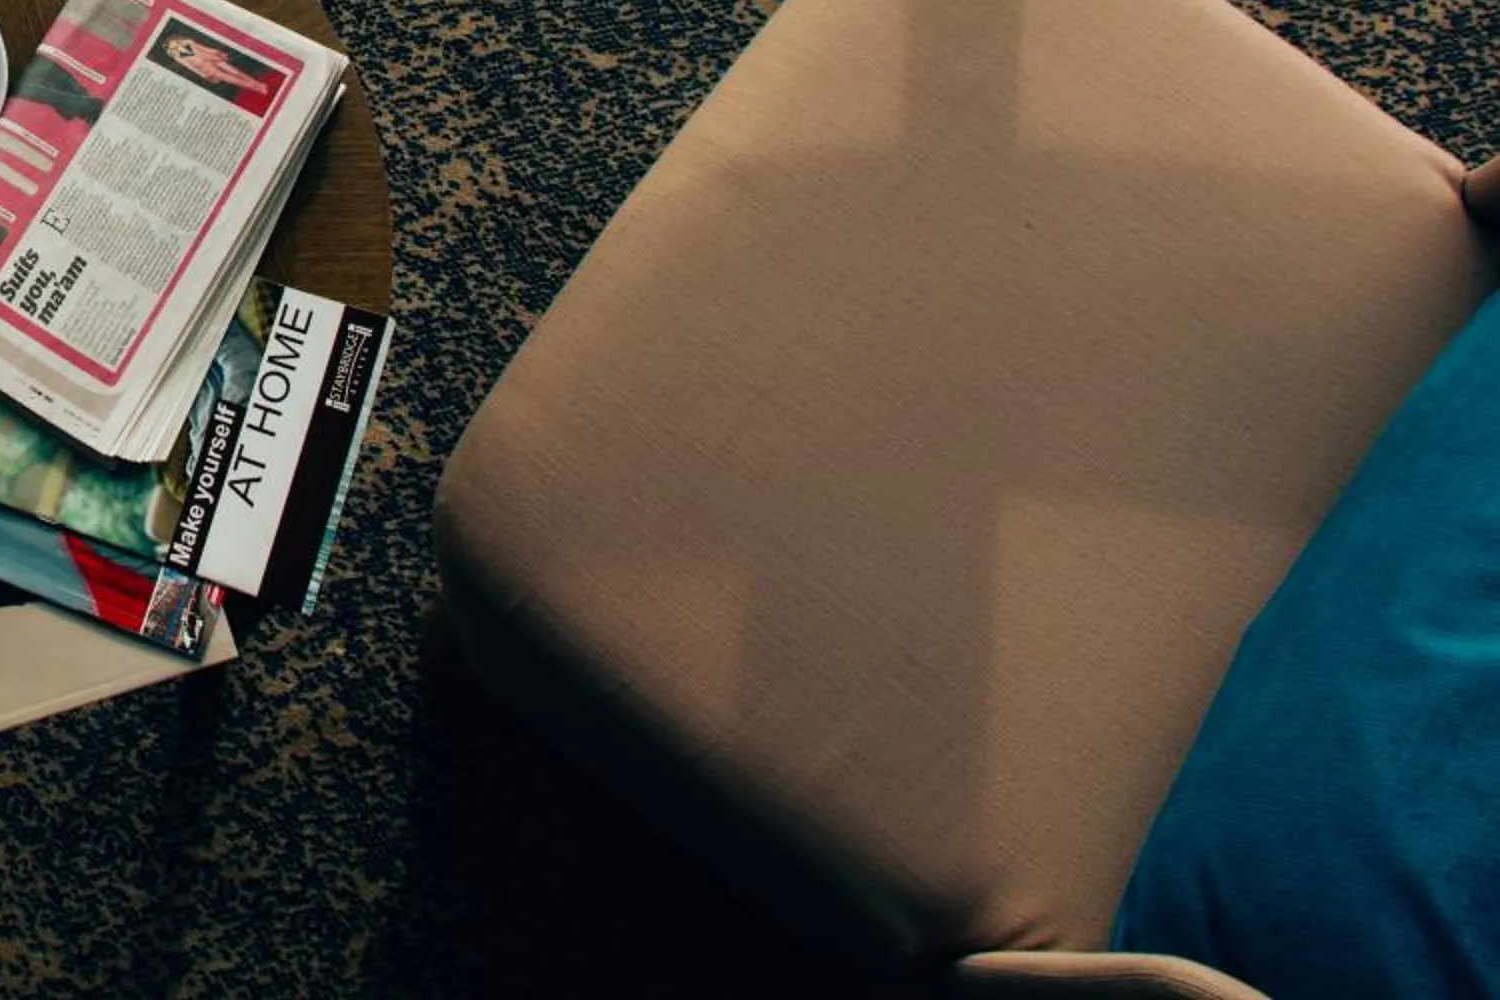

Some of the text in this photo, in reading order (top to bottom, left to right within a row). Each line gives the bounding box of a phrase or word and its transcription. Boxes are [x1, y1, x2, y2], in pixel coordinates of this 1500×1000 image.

[0, 248, 40, 303] Suits
[20, 270, 56, 317] you,
[38, 255, 88, 326] ma'am
[227, 303, 314, 509] AT HOME
[169, 403, 237, 567] Make yourself
